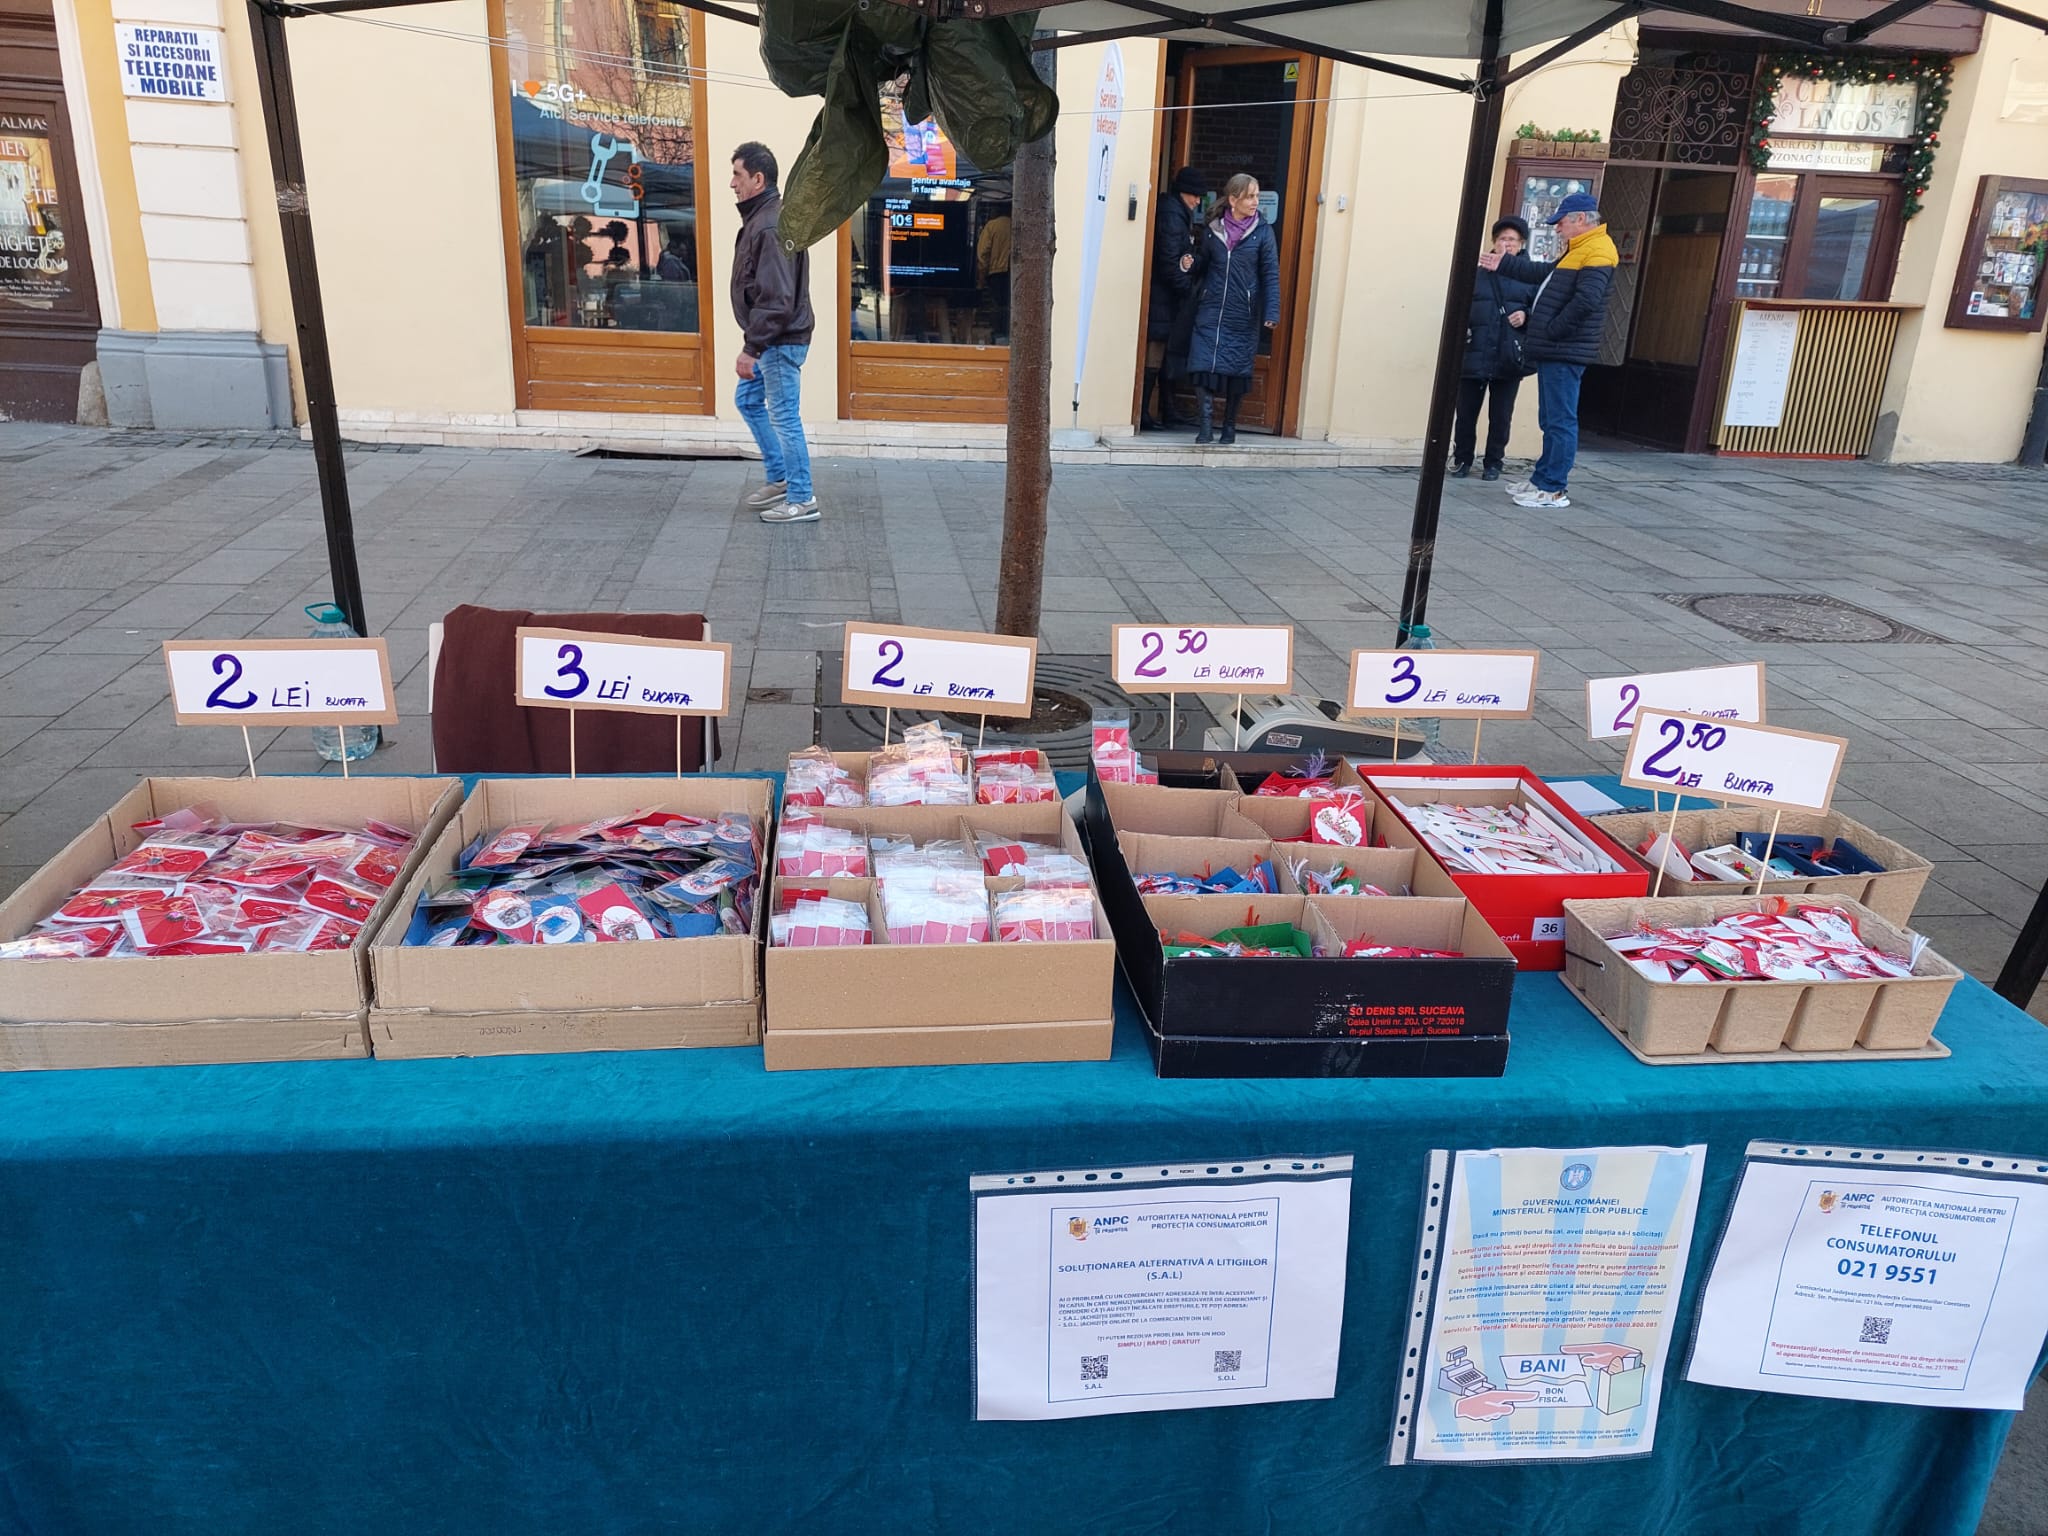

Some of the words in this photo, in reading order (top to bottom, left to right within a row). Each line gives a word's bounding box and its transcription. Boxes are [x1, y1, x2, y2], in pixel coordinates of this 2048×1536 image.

[135, 28, 198, 45] REPARATII
[128, 43, 140, 57] SI
[144, 45, 210, 62] ACCESORII
[124, 59, 216, 81] TELEFOANE
[140, 78, 205, 97] MOBILE
[546, 83, 587, 103] 5G+
[539, 108, 565, 120] Aici
[568, 109, 620, 124] Service
[623, 113, 685, 128] telefoane
[1798, 108, 1882, 132] LANGOS
[912, 177, 937, 185] pentru
[872, 640, 905, 688] 2
[1134, 632, 1167, 678] 2
[1219, 665, 1265, 680] BUCATA
[206, 653, 258, 710] 2
[324, 696, 369, 707] BUCATA
[544, 643, 590, 699] 3
[642, 688, 693, 706] BUCATA
[1385, 655, 1422, 704] 3
[1456, 692, 1502, 705] BUCATA
[1613, 683, 1640, 731] 2
[1642, 718, 1685, 779] 2
[1723, 772, 1774, 797] BUCATA
[1541, 923, 1558, 933] 36
[1349, 1007, 1363, 1016] SC
[1366, 1006, 1396, 1016] DENIS
[1397, 1006, 1416, 1016] SRL
[1419, 1006, 1465, 1015] SUCEAVA
[1347, 1018, 1370, 1026] Calea
[1372, 1017, 1391, 1026] Unirii
[1392, 1018, 1402, 1026] nr.
[1423, 1017, 1434, 1025] CP
[1411, 1027, 1425, 1036] jud.
[1574, 1197, 1620, 1206] ROMÂNIEI
[1842, 1193, 1875, 1203] ANPC
[1880, 1195, 1932, 1208] AUTORITATEA
[1977, 1207, 2007, 1216] PENTRU
[1137, 1213, 1190, 1222] AUTORITATEA
[1238, 1211, 1269, 1220] PENTRU
[1492, 1207, 1546, 1217] MINISTERUL
[1548, 1206, 1605, 1216] FINANȚELOR
[1607, 1208, 1649, 1216] PUBLICE
[1928, 1211, 1997, 1224] CONSUMATORILOR
[1093, 1216, 1129, 1227] ANPC
[1196, 1219, 1268, 1229] CONSUMATORILOR
[1860, 1223, 1939, 1244] TELEFONUL
[1826, 1237, 1957, 1263] CONSUMATORULUI
[1207, 1259, 1215, 1267] A
[1216, 1257, 1268, 1267] LITIGIILOR
[1837, 1258, 1877, 1279] 021
[1884, 1264, 1937, 1285] 9551
[1146, 1270, 1183, 1281] (S.A.L)
[1520, 1359, 1566, 1373] BANI
